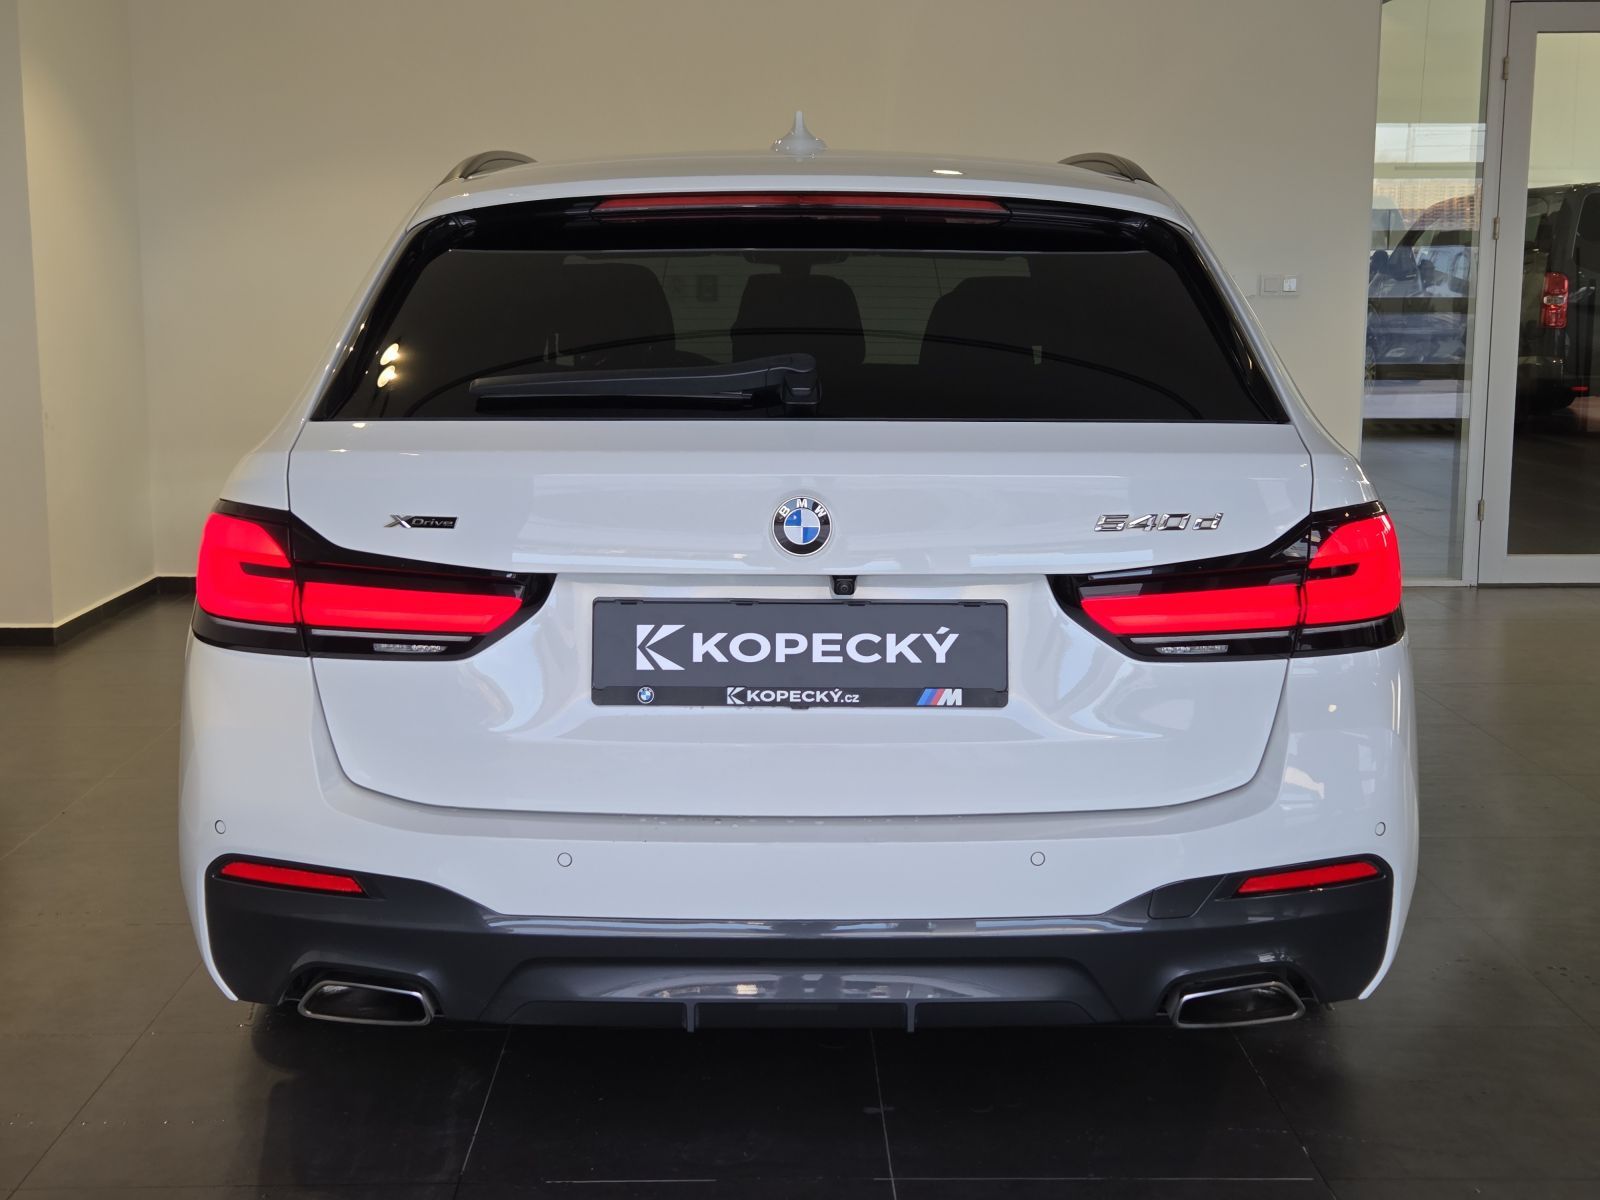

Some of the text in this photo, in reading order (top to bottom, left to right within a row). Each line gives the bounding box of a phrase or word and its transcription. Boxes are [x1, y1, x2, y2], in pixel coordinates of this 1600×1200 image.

[779, 498, 827, 518] BMW
[692, 626, 960, 664] KOPECKÝ
[936, 688, 963, 706] M
